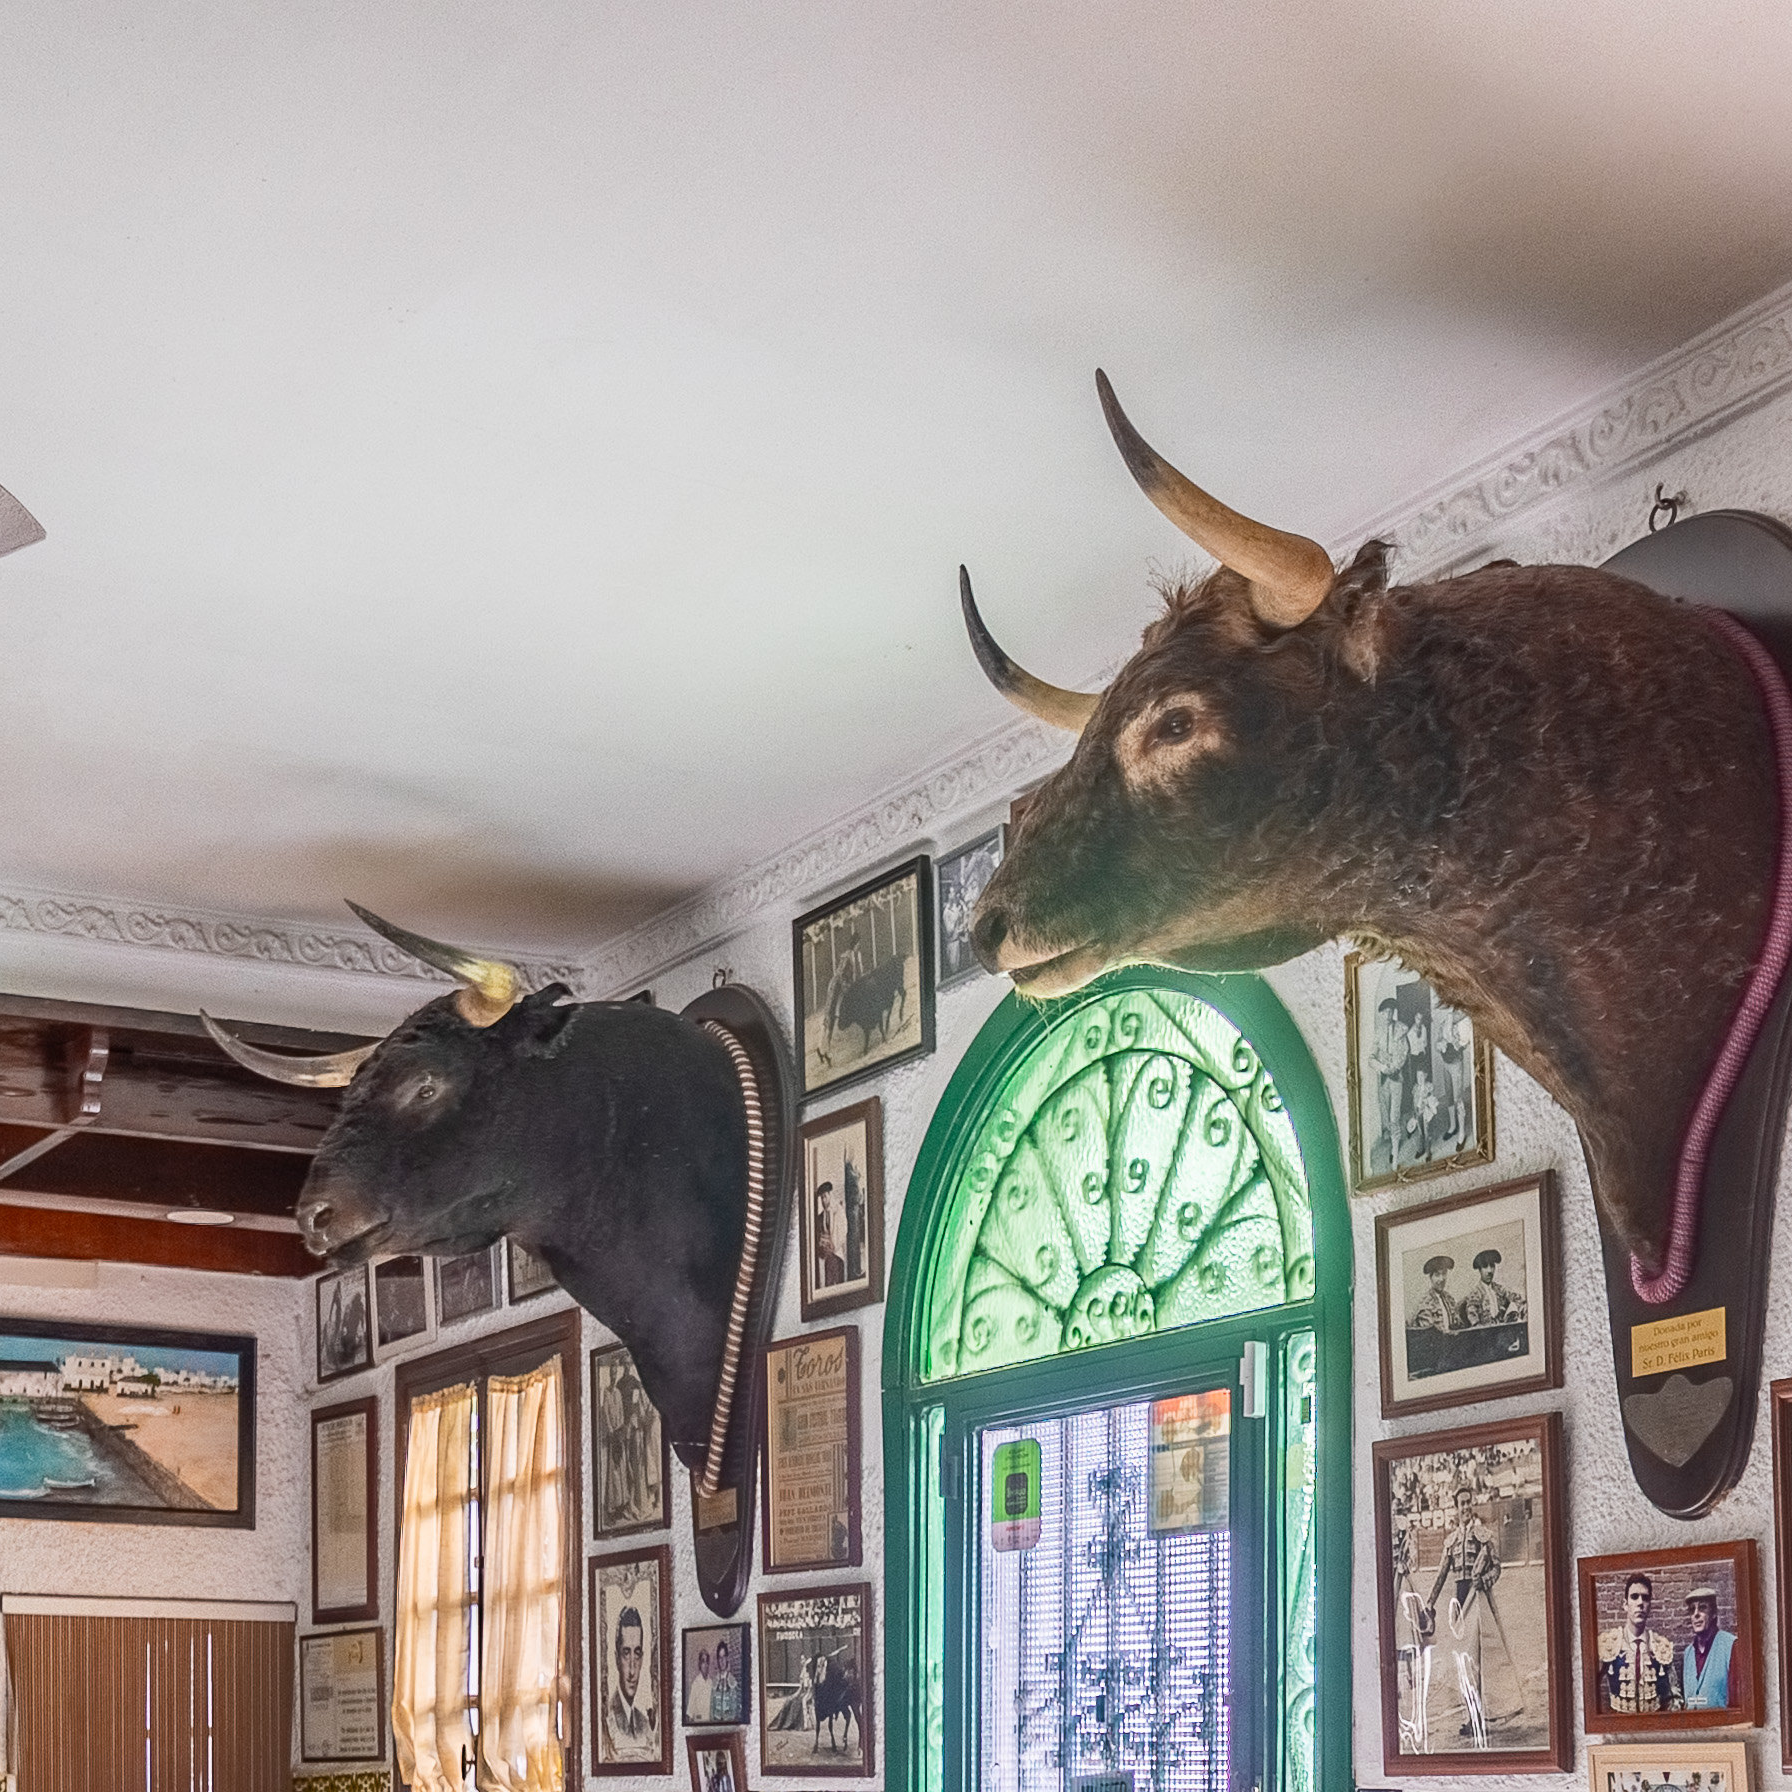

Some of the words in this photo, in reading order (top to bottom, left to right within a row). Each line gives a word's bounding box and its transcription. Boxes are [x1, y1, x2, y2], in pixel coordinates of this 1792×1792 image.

[1653, 1322, 1685, 1337] Donada
[1687, 1318, 1703, 1332] por
[1638, 1341, 1670, 1353] nuestro
[1670, 1335, 1690, 1348] gran
[1691, 1330, 1719, 1343] amigo
[793, 1345, 844, 1380] Toros
